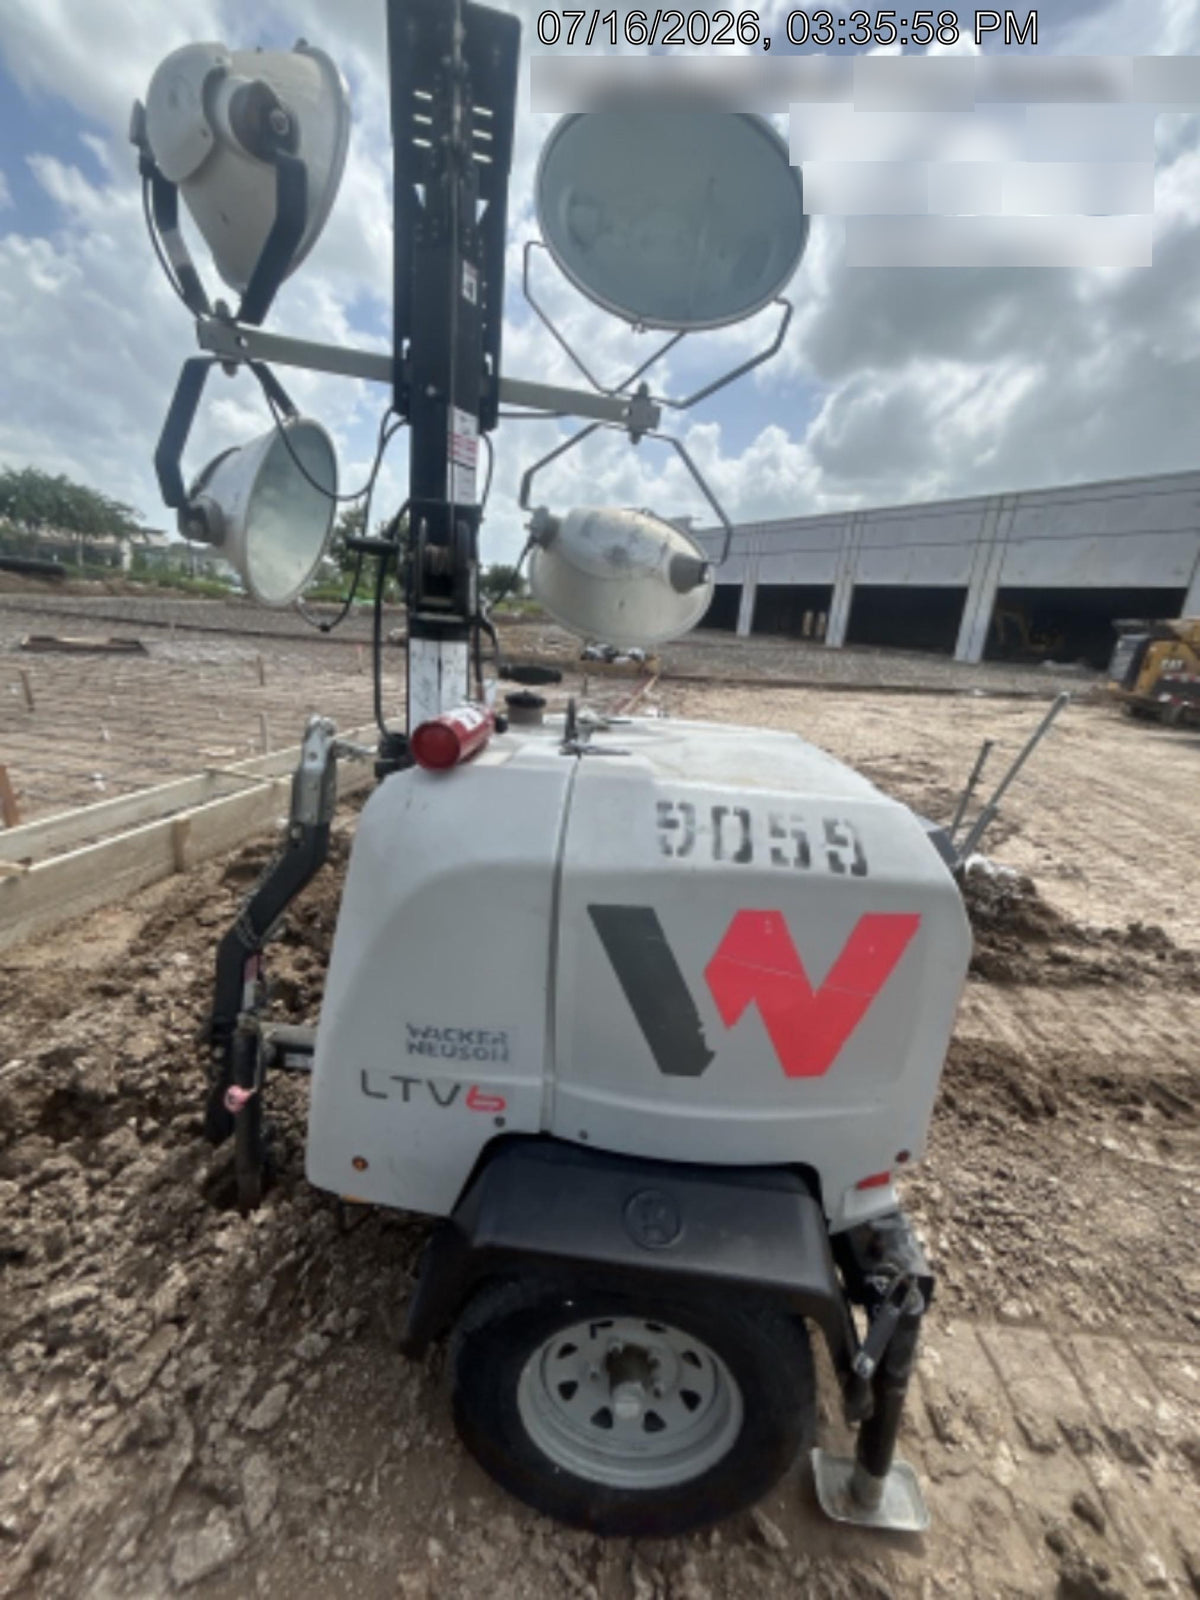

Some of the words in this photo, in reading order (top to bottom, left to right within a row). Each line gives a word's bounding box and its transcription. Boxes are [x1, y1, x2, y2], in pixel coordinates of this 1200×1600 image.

[406, 1022, 508, 1044] WACKER
[407, 1038, 509, 1062] NEUSON
[360, 1068, 507, 1112] LTV6
